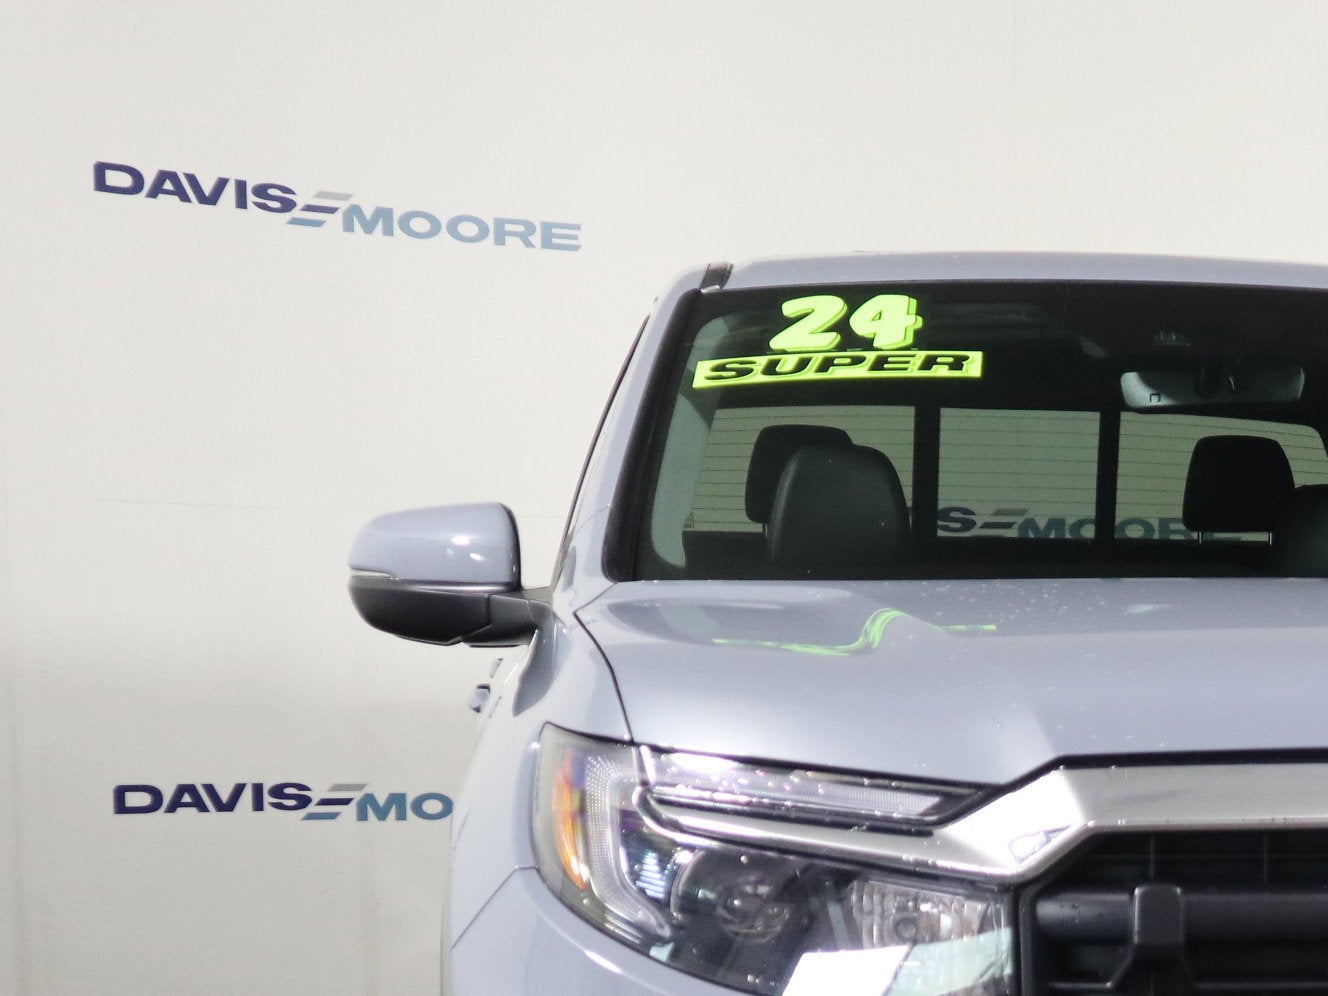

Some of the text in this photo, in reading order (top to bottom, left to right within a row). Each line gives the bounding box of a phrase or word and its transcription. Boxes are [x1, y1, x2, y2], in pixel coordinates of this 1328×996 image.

[93, 160, 582, 252] DAVIS MOORE
[769, 294, 923, 352] 24
[703, 352, 976, 381] SUPER
[1018, 517, 1241, 539] MOOR
[113, 782, 313, 815] DAVIS
